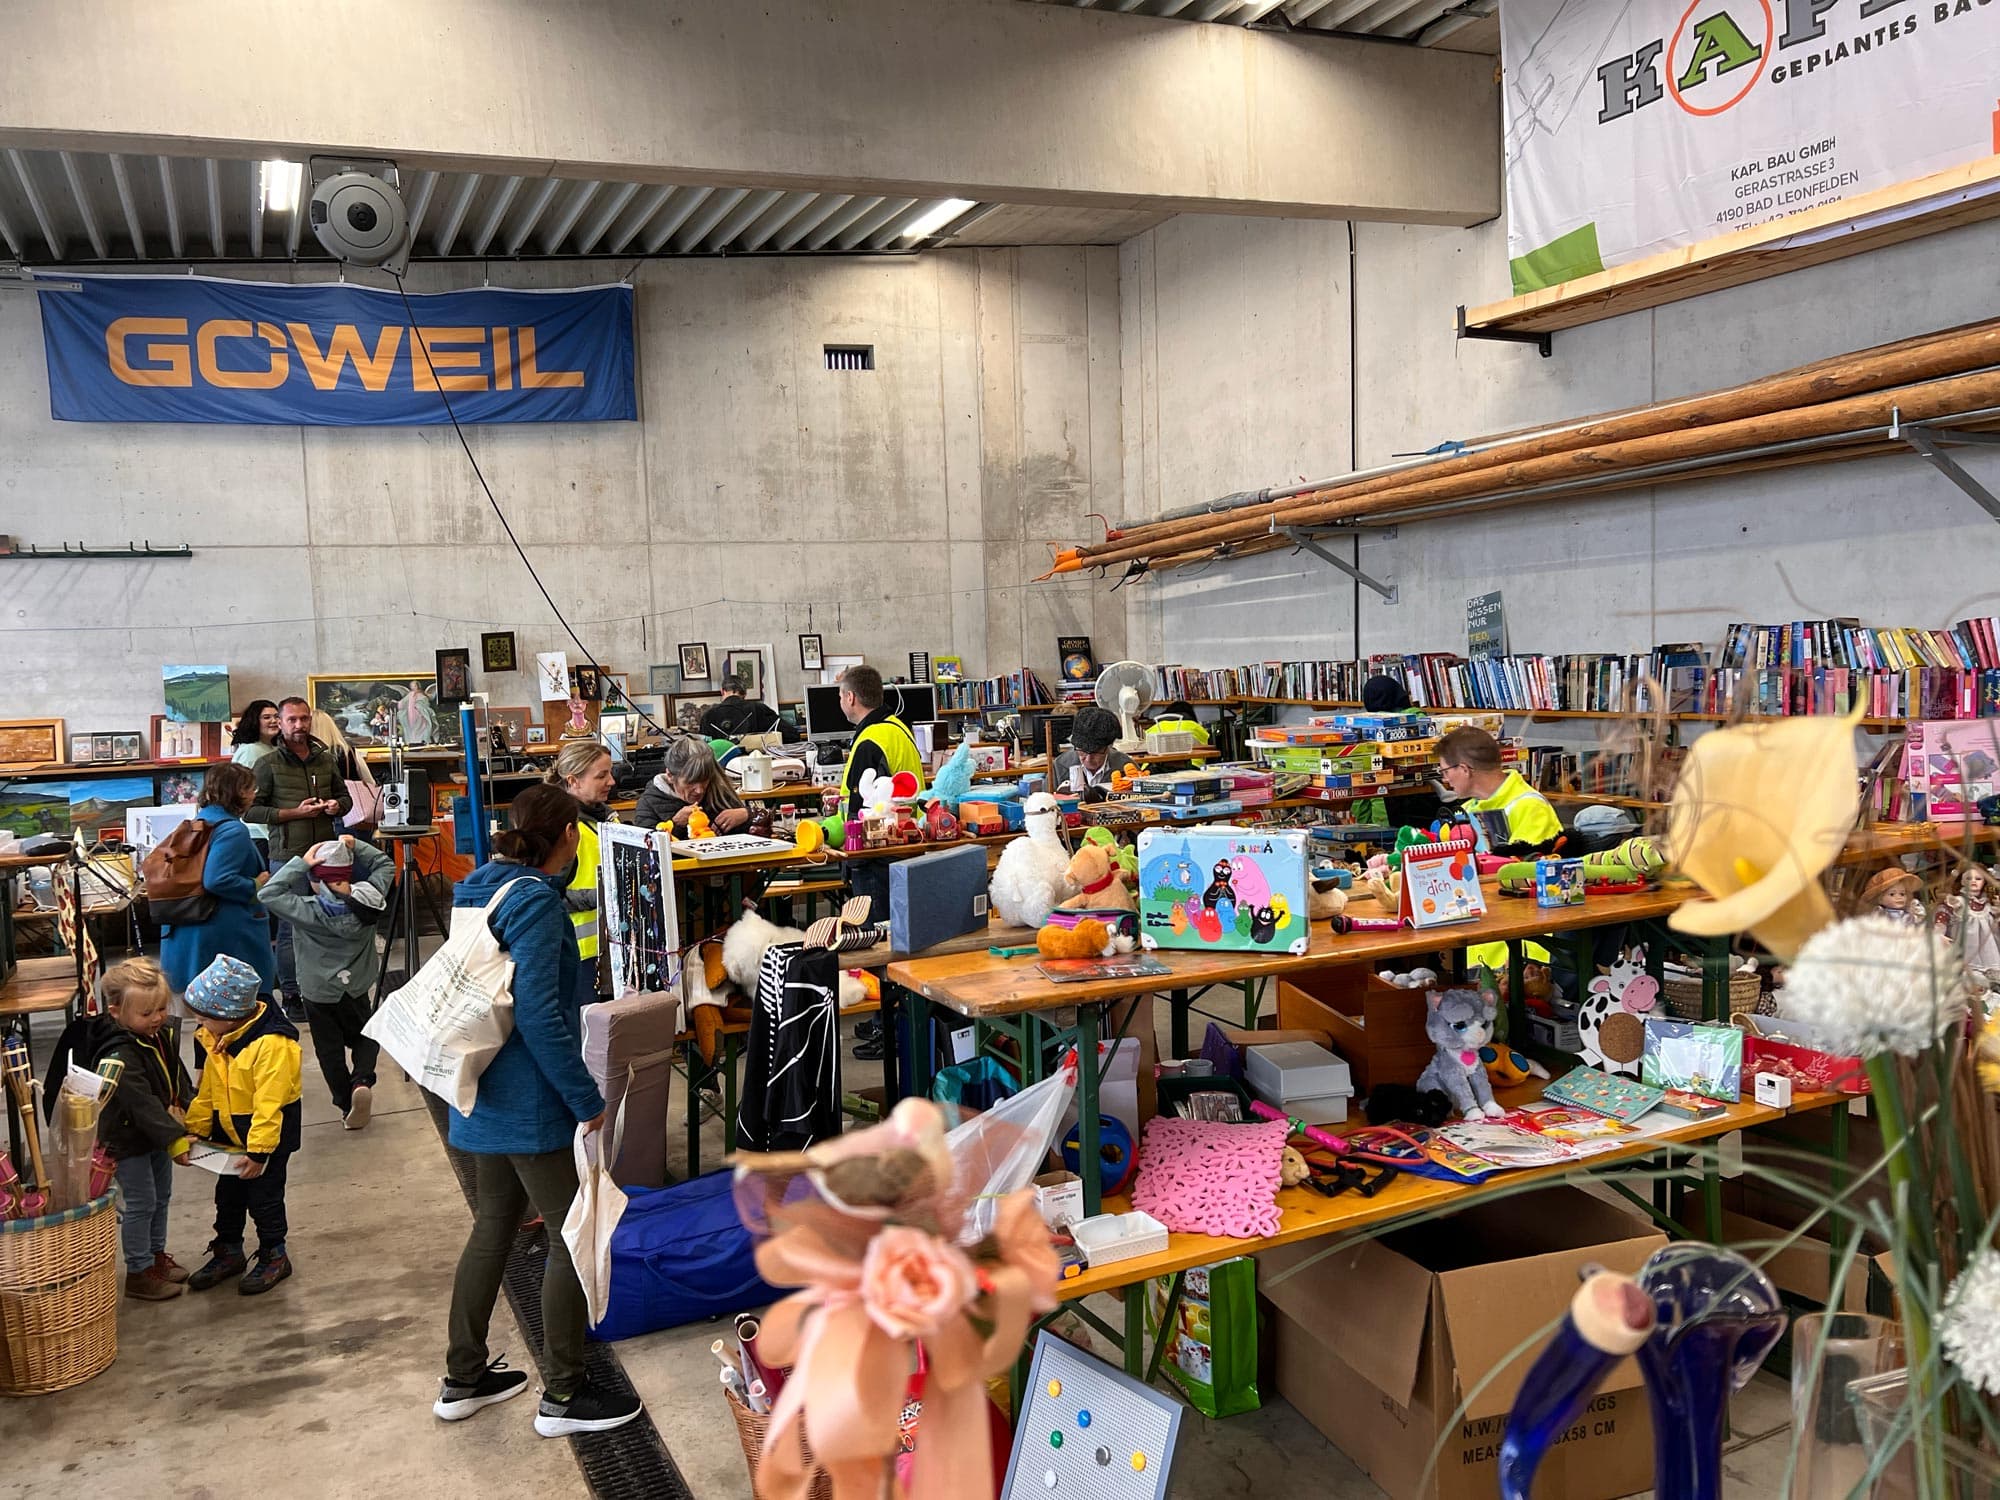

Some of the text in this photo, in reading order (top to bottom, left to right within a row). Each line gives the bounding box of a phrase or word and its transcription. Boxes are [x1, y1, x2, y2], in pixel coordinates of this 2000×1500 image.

[1771, 0, 1993, 84] GEPLANTES BA
[1598, 0, 1901, 124] KAP
[1731, 136, 1836, 181] KAPL BAU GMBH
[1735, 157, 1835, 198] GERASTRASSE 3
[1716, 206, 1744, 223] 4190
[1746, 197, 1773, 215] BAD
[1777, 170, 1860, 206] LEONFELDEN
[1467, 597, 1485, 609] DAS
[1468, 617, 1487, 629] NUR
[1469, 638, 1499, 653] FRANK
[1427, 880, 1452, 896] dich
[1594, 1420, 1615, 1436] CM
